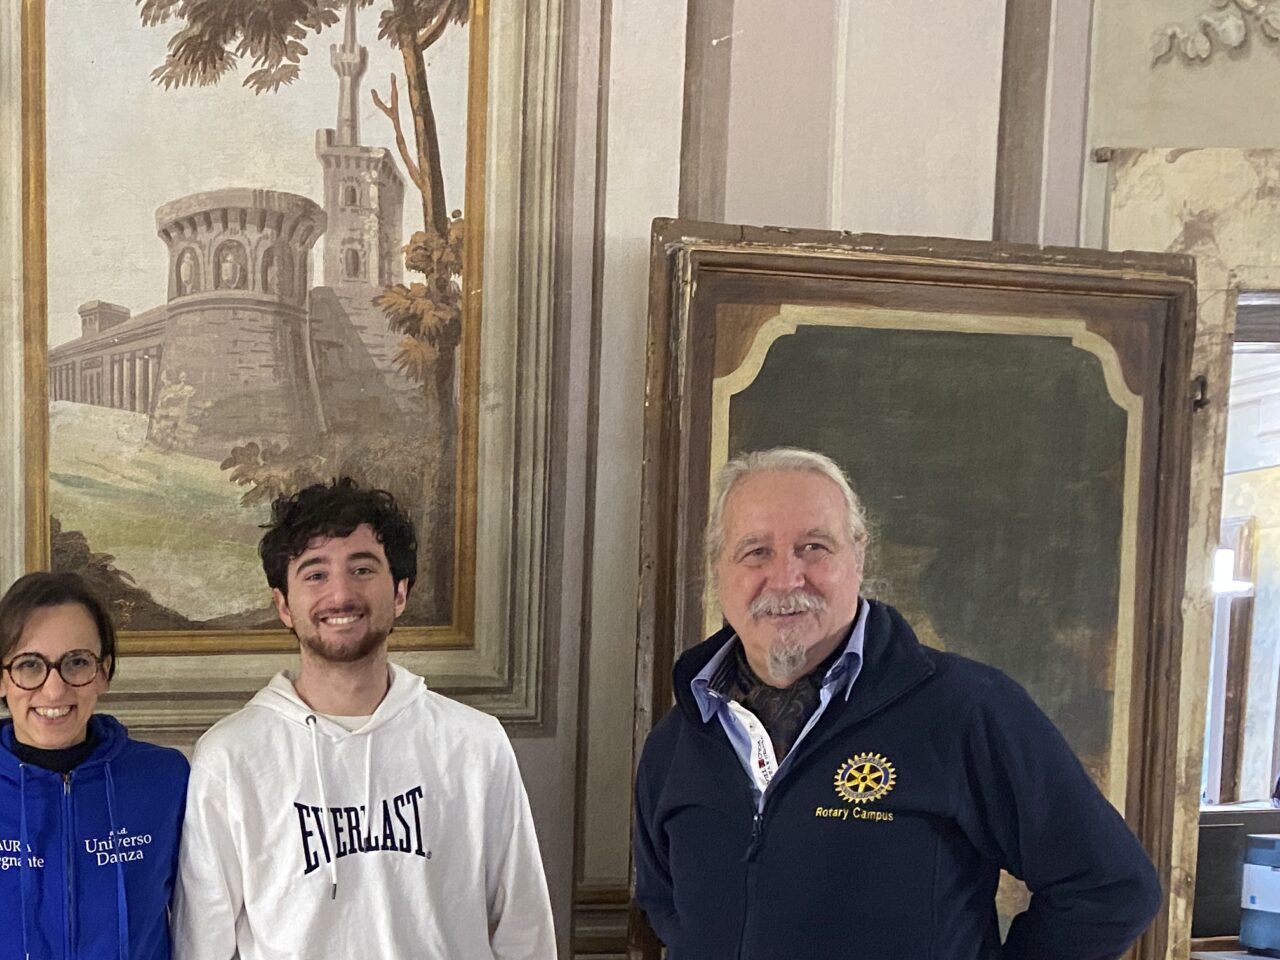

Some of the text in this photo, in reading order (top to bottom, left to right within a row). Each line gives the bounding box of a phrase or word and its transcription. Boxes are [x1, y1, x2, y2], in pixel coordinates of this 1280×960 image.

[815, 806, 894, 822] Rotary Campus
[96, 849, 144, 866] Danza
